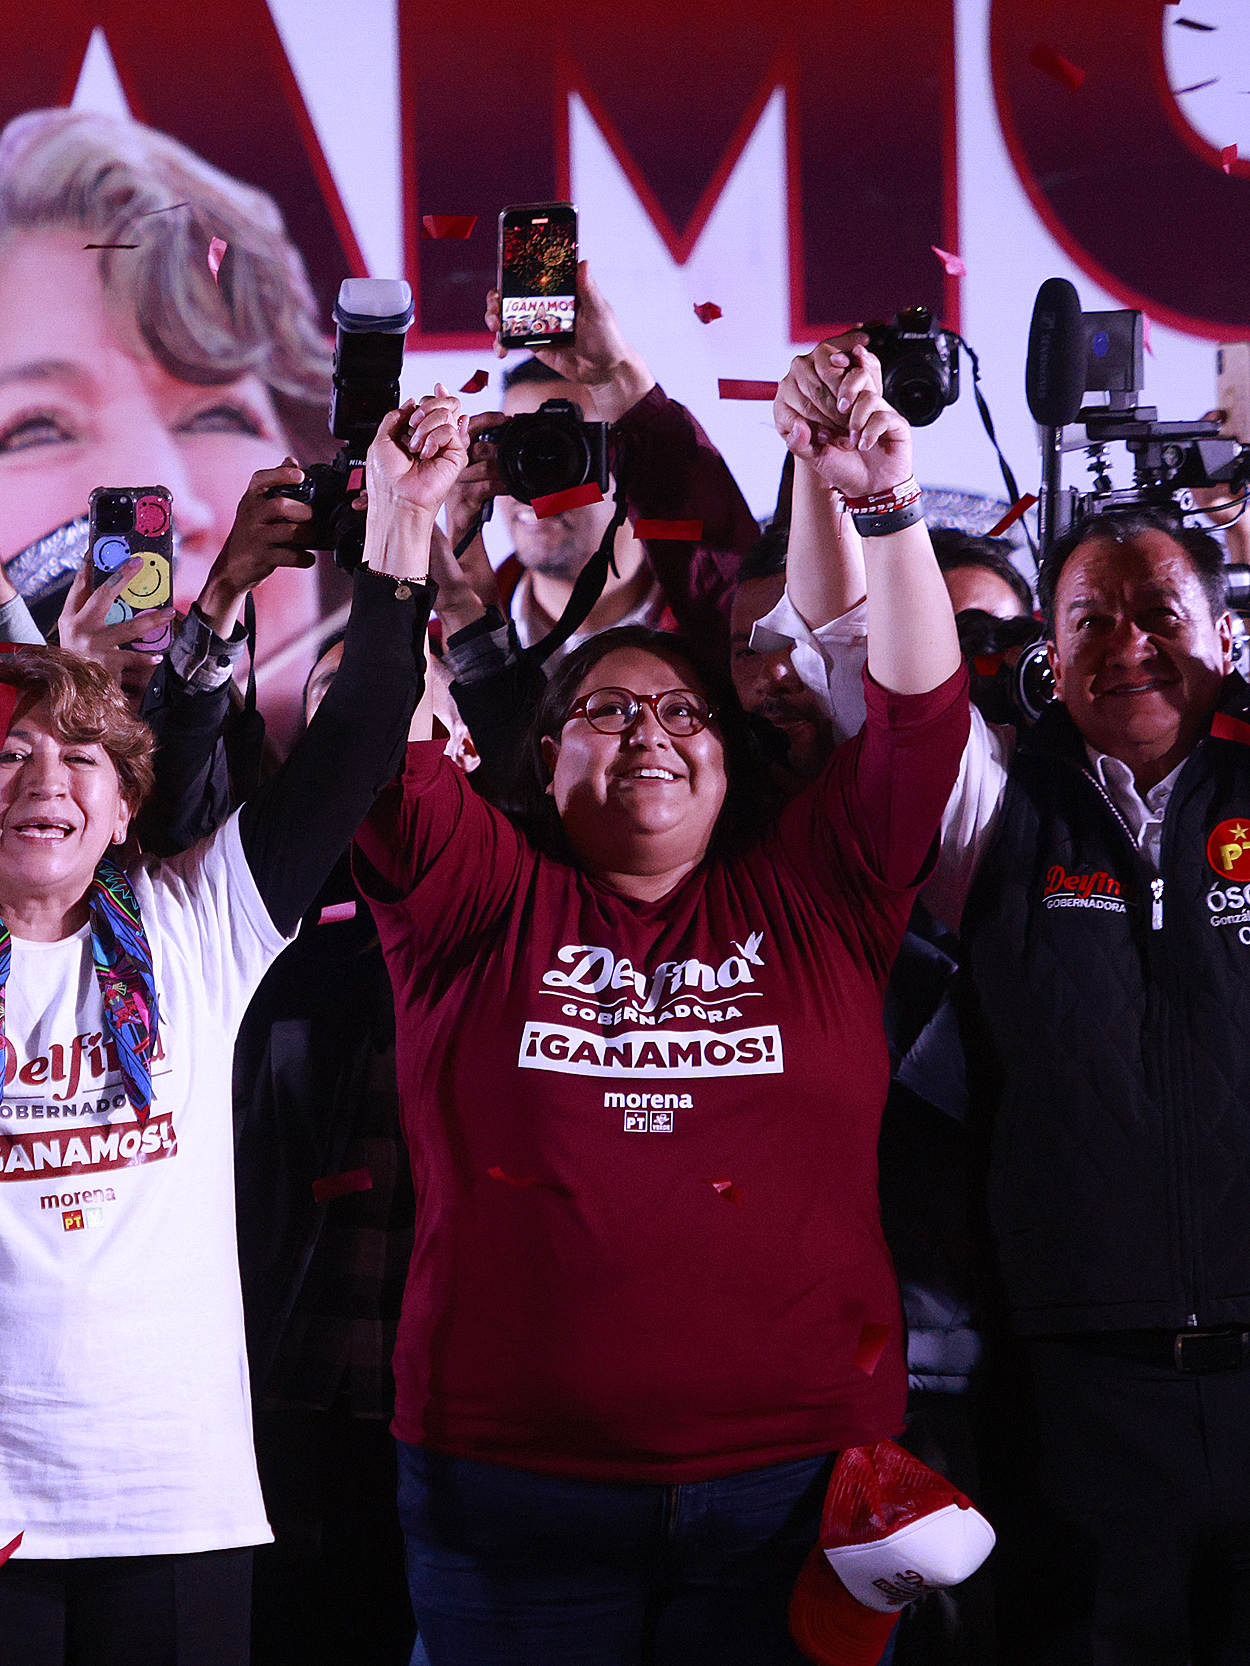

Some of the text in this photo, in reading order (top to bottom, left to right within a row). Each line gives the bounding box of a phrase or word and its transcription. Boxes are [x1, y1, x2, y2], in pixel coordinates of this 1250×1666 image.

[1043, 865, 1124, 899] Delfin
[1046, 898, 1127, 913] GOBERNADORA
[542, 944, 755, 1013] Delfina
[561, 1003, 743, 1025] GOBERNADORA
[525, 1031, 776, 1068] ¡GANAMOS!
[603, 1091, 694, 1109] morena
[626, 1116, 646, 1130] PT
[40, 1187, 117, 1210] morena
[65, 1216, 81, 1229] PT
